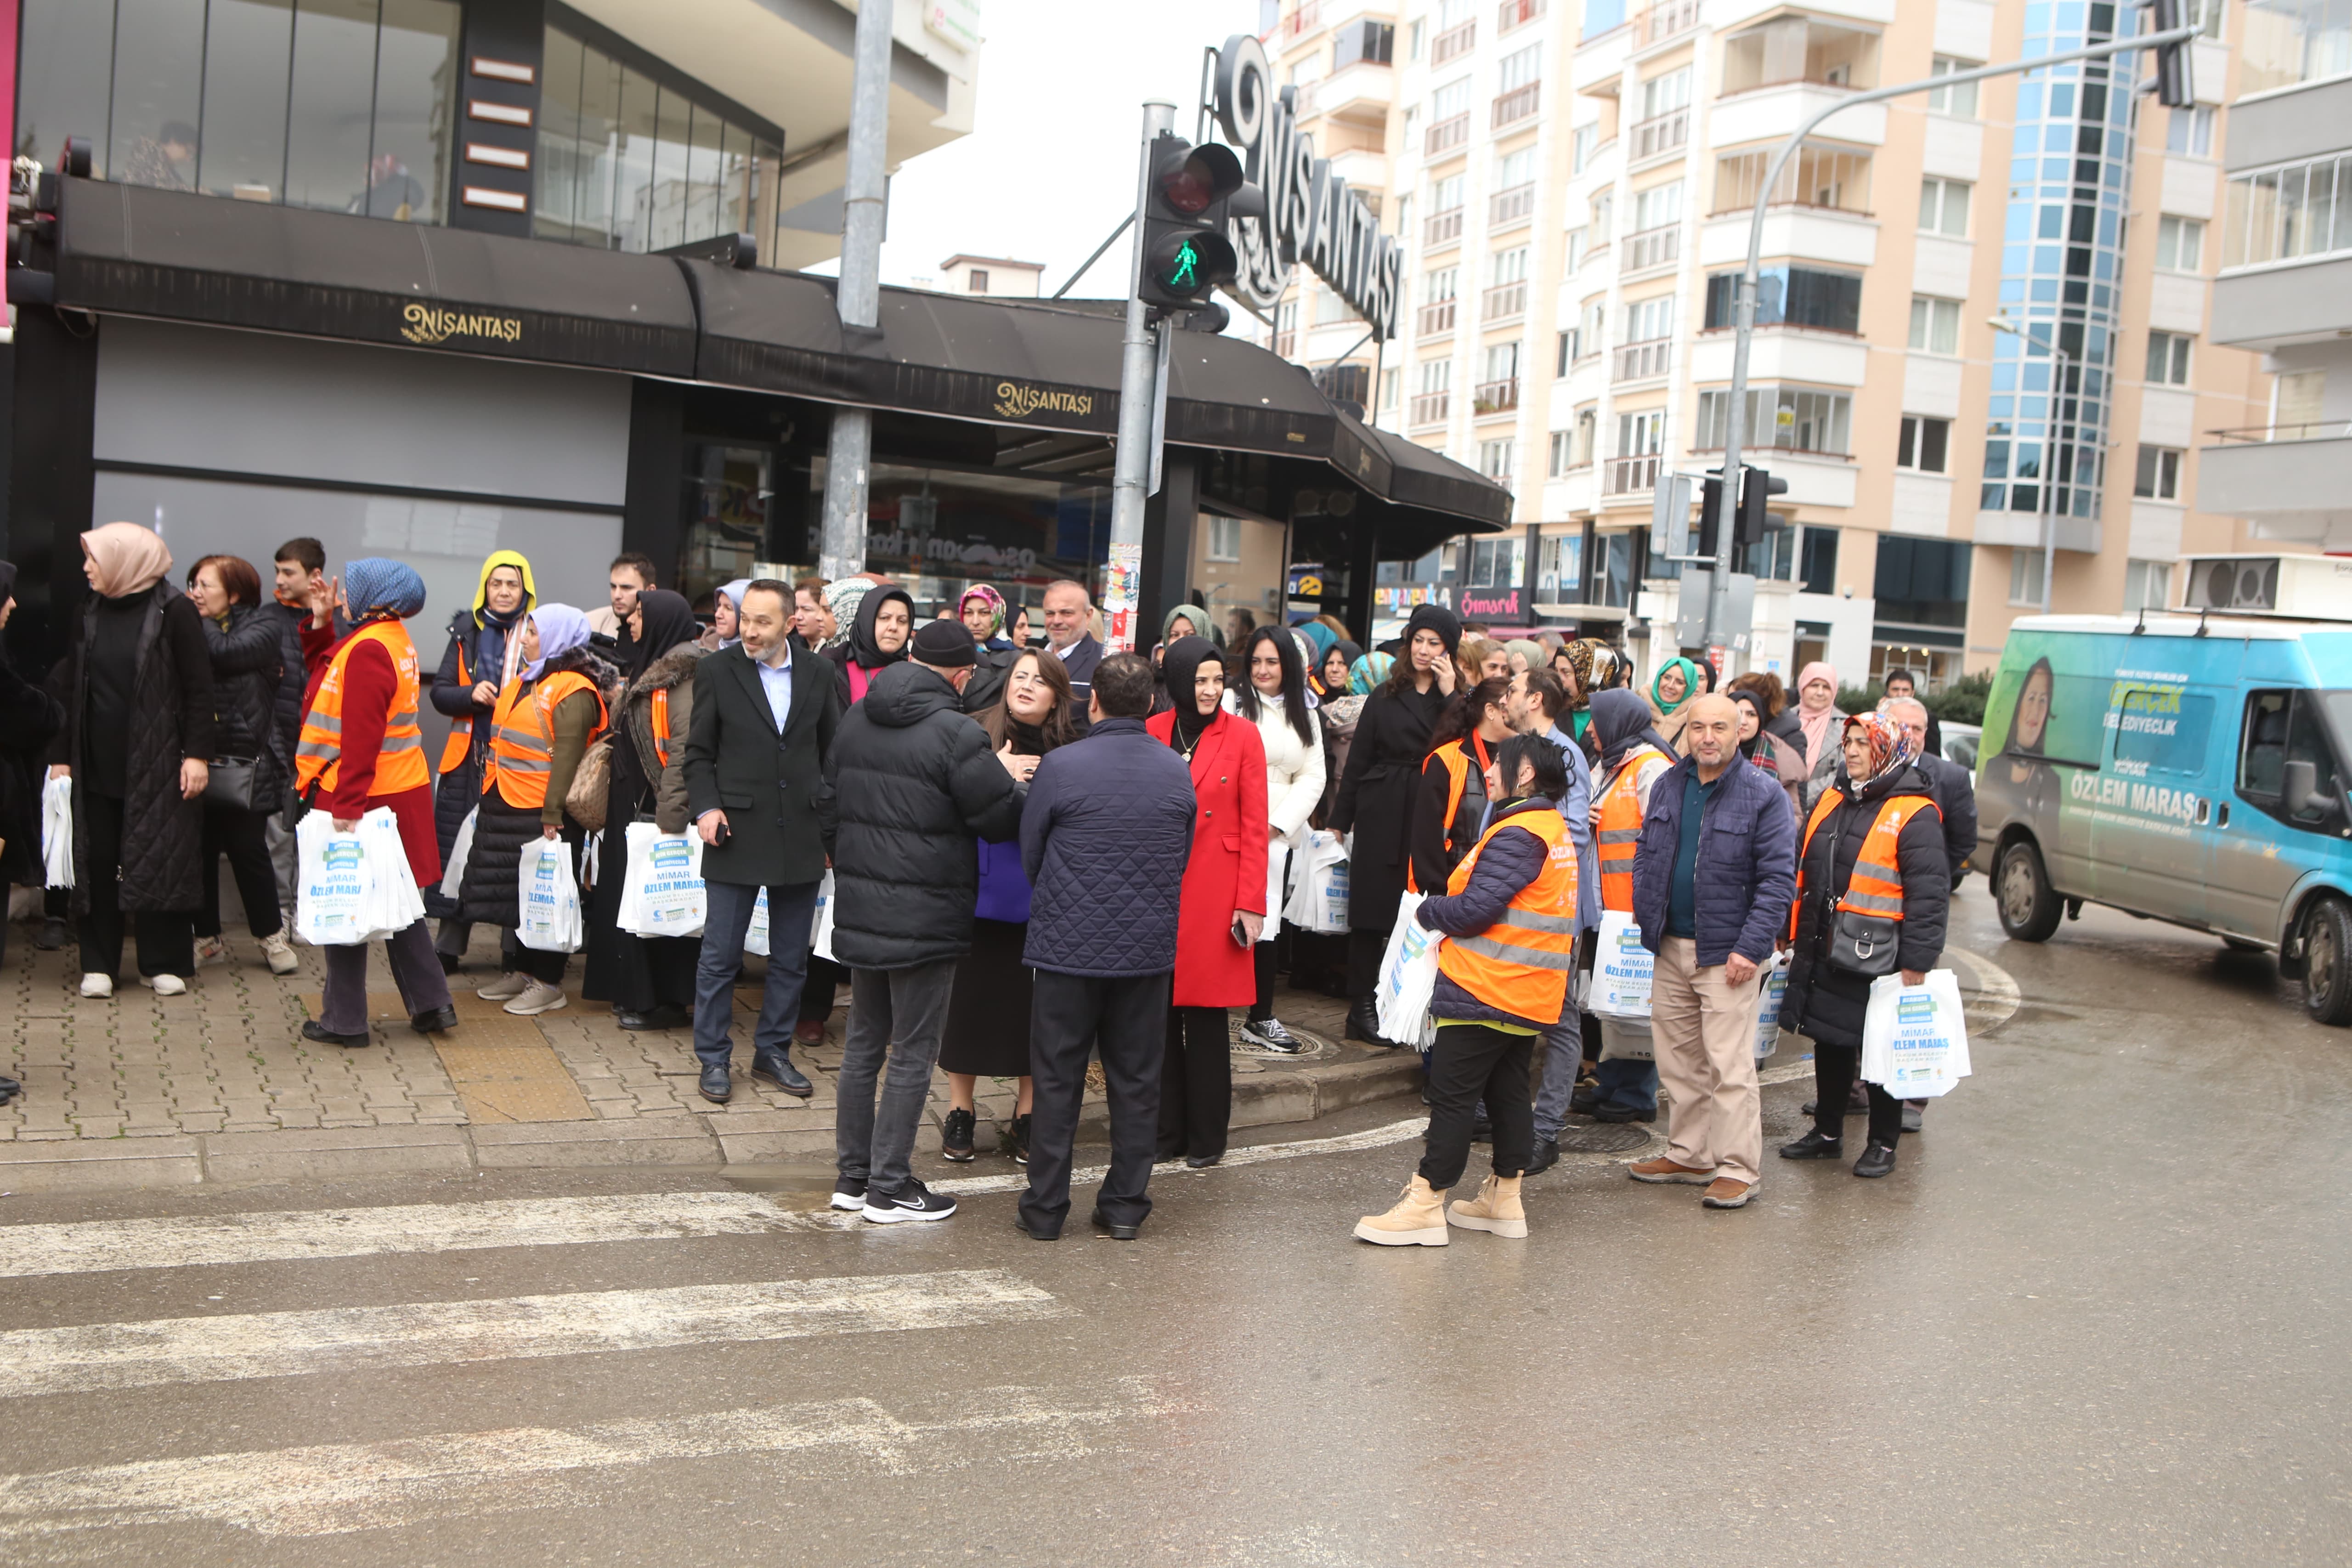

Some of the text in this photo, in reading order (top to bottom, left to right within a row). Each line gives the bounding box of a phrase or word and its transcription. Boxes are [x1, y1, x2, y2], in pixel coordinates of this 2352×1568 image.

[402, 304, 521, 343] NİŞANTAŞI
[996, 382, 1092, 416] NİŞANTAŞI
[2109, 680, 2185, 715] GERÇEK
[2071, 767, 2196, 827] ÖZLEM MARAŞ
[644, 879, 705, 894] ÖZLEM MARAŞ
[657, 871, 690, 880] MİMAR
[1605, 964, 1633, 978] ÖZLEM
[1621, 958, 1653, 968] MİMAR
